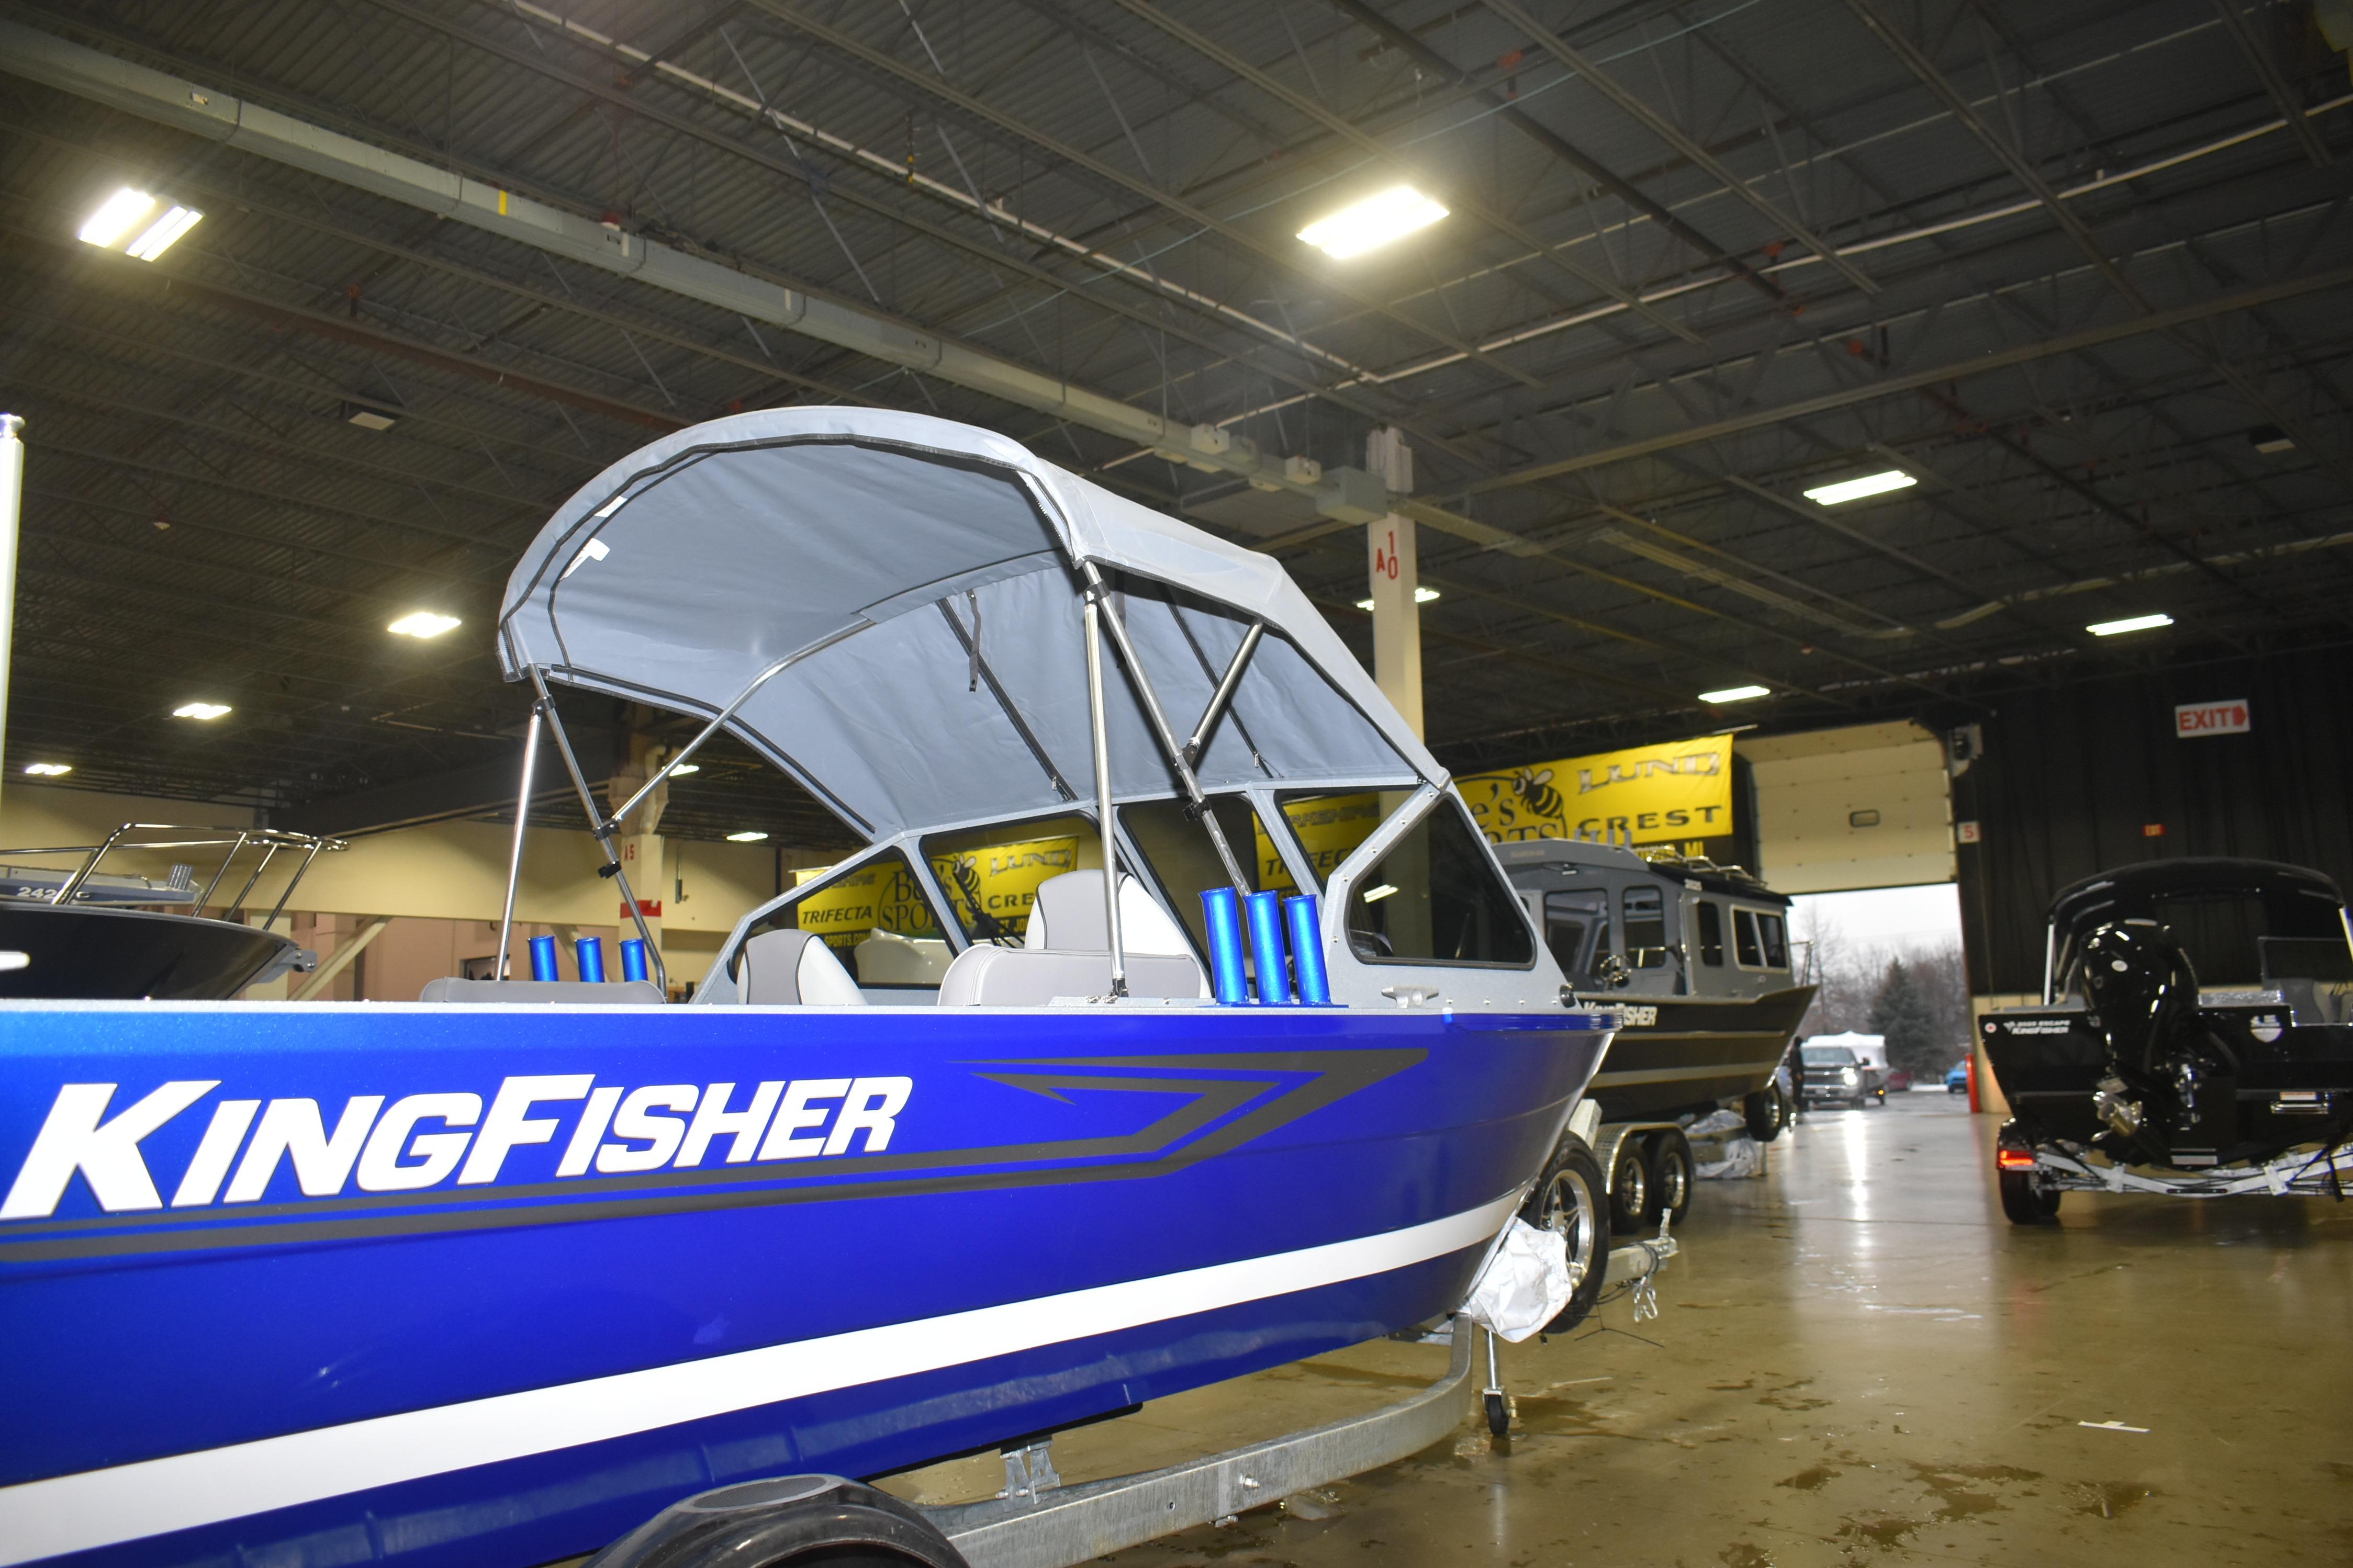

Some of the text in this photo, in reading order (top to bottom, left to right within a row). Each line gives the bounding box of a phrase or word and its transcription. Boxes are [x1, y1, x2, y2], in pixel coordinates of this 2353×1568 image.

[2179, 707, 2231, 730] EXIT
[1577, 752, 1720, 795] LUND
[1577, 806, 1722, 836] CREST
[989, 849, 1072, 877] LUND
[988, 893, 1035, 909] CRE
[802, 906, 872, 924] TRIFECTA
